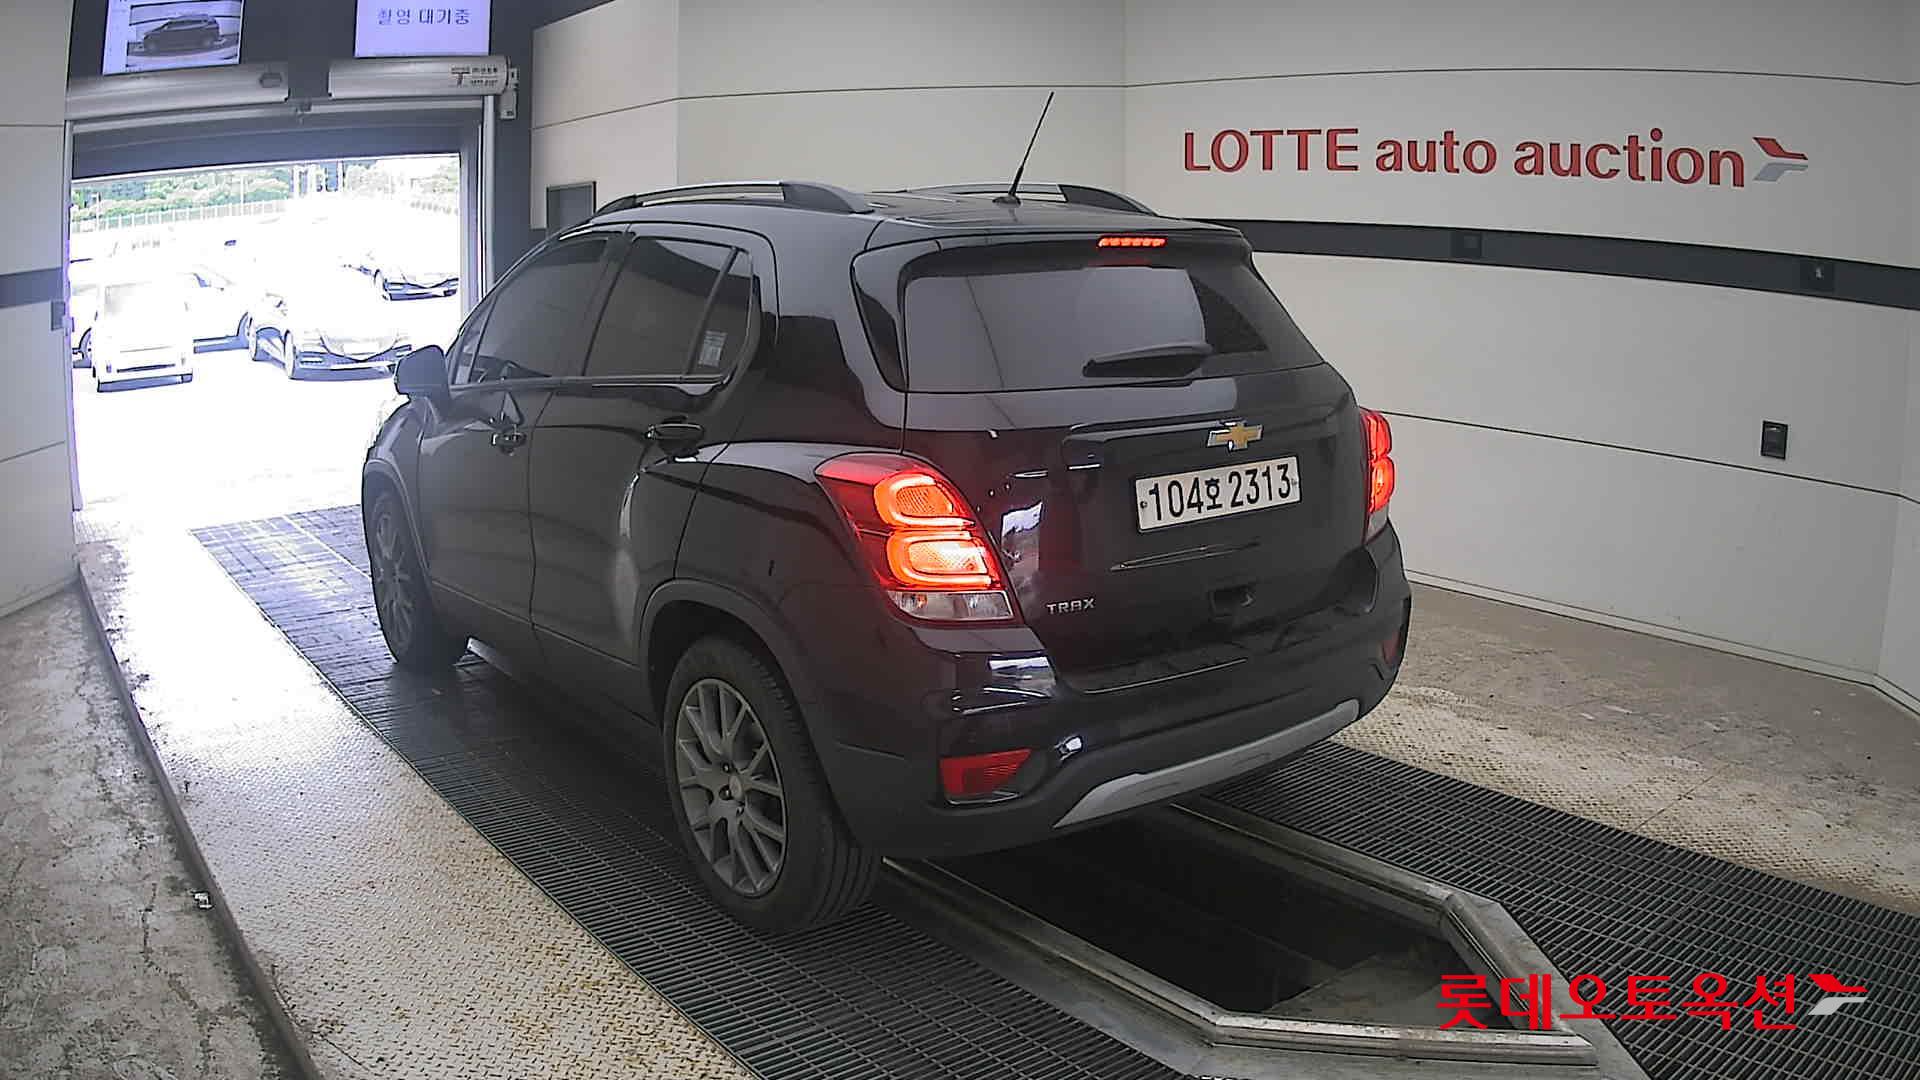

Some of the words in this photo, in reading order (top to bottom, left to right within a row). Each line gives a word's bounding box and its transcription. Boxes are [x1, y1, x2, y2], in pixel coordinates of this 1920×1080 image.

[418, 8, 470, 25] 대기중
[1184, 128, 1359, 173] LOTTE
[1375, 130, 1497, 175] auto
[1514, 128, 1745, 187] auction
[1149, 476, 1223, 521] 104호
[1228, 463, 1291, 508] 2313
[1046, 598, 1095, 614] TRAX
